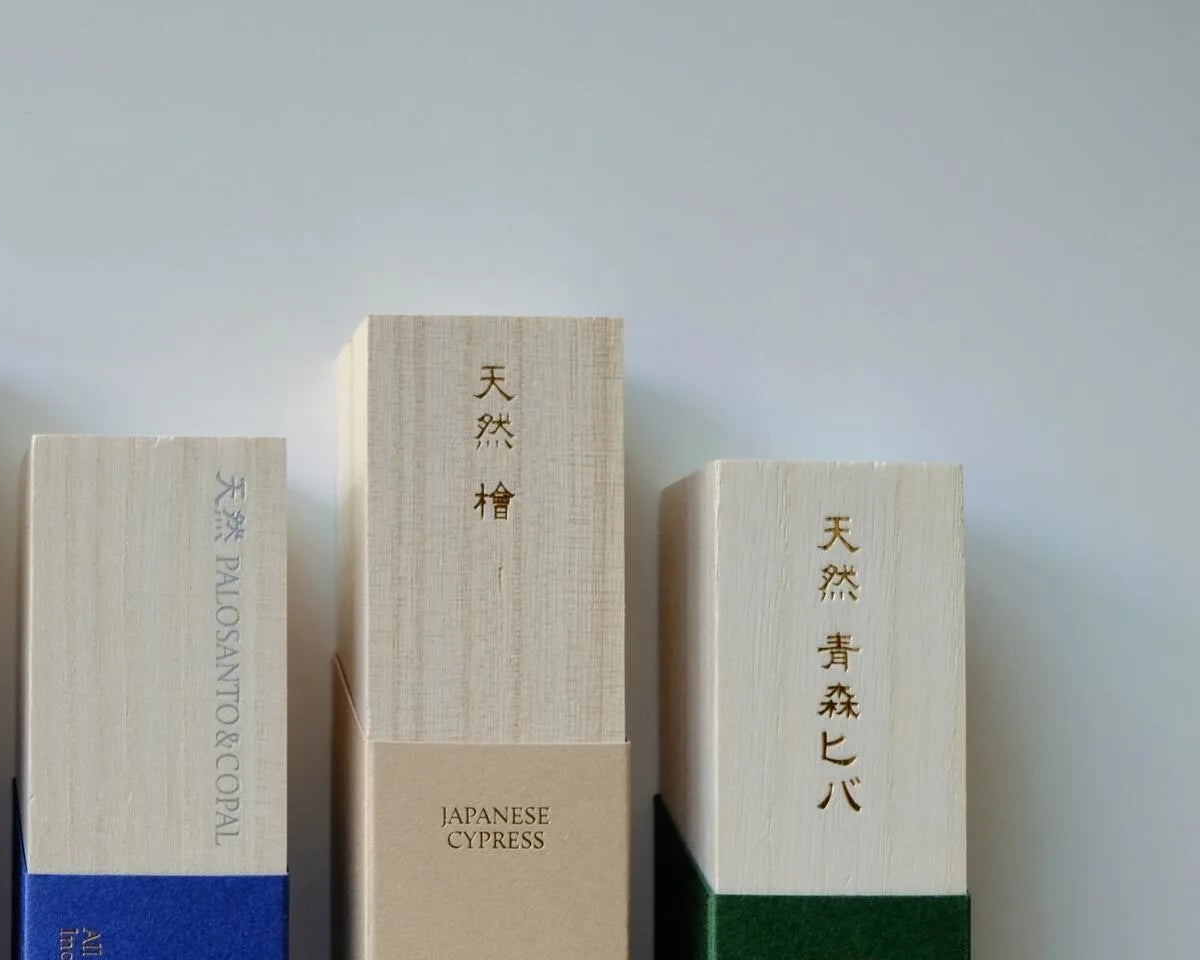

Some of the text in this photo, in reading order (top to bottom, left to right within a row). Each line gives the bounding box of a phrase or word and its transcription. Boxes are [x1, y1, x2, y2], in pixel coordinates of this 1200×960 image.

[473, 365, 516, 521] 天然 檜
[215, 471, 247, 542] 天然
[817, 516, 862, 813] 天然 青森ヒバ
[441, 806, 551, 829] JAPANESE
[447, 830, 546, 850] CYPRESS
[81, 927, 103, 957] All
